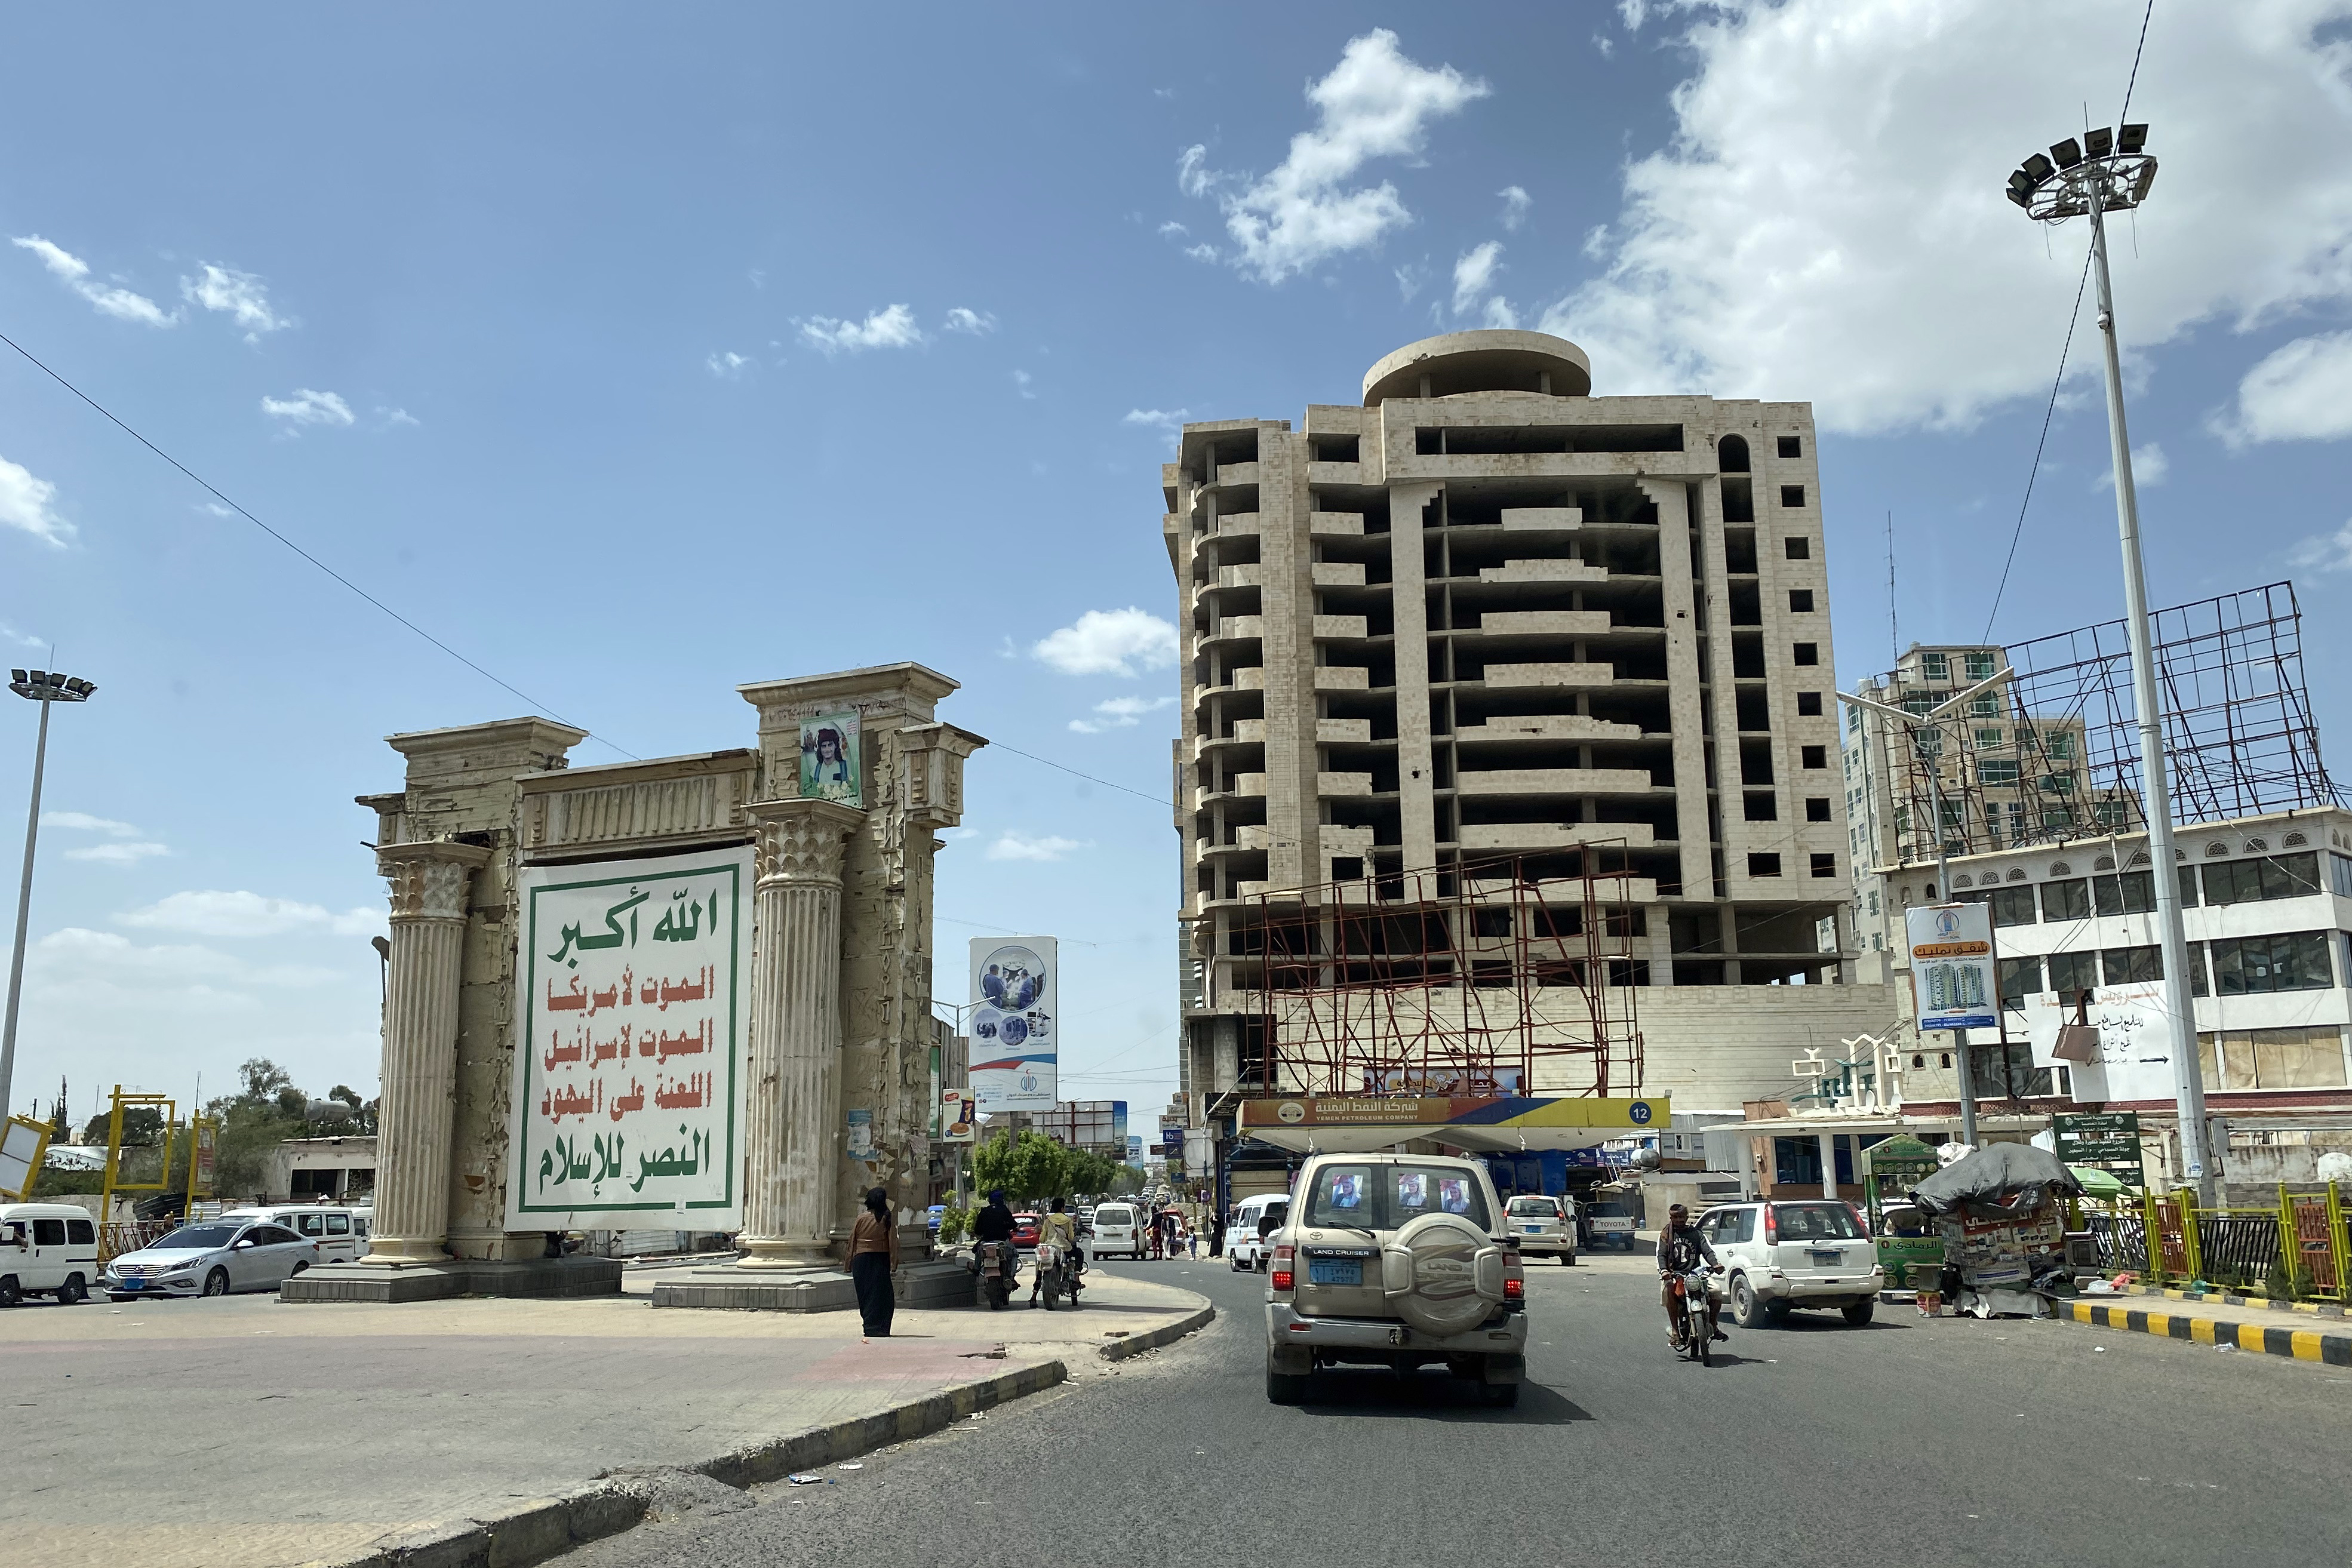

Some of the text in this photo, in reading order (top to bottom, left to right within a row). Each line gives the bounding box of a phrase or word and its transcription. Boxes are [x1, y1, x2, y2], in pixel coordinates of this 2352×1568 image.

[548, 886, 717, 969] الله أكبر
[1915, 942, 1988, 958] شقق تمليك
[641, 963, 714, 1012] الموت
[639, 1017, 713, 1065] الموت
[542, 1069, 712, 1125] اللعنة على اليهود
[1315, 1101, 1418, 1114] شركة النفط اليمنية
[1634, 1108, 1647, 1118] 12
[540, 1123, 709, 1199] النصر للإسلام
[1893, 1241, 1938, 1250] الرمادي
